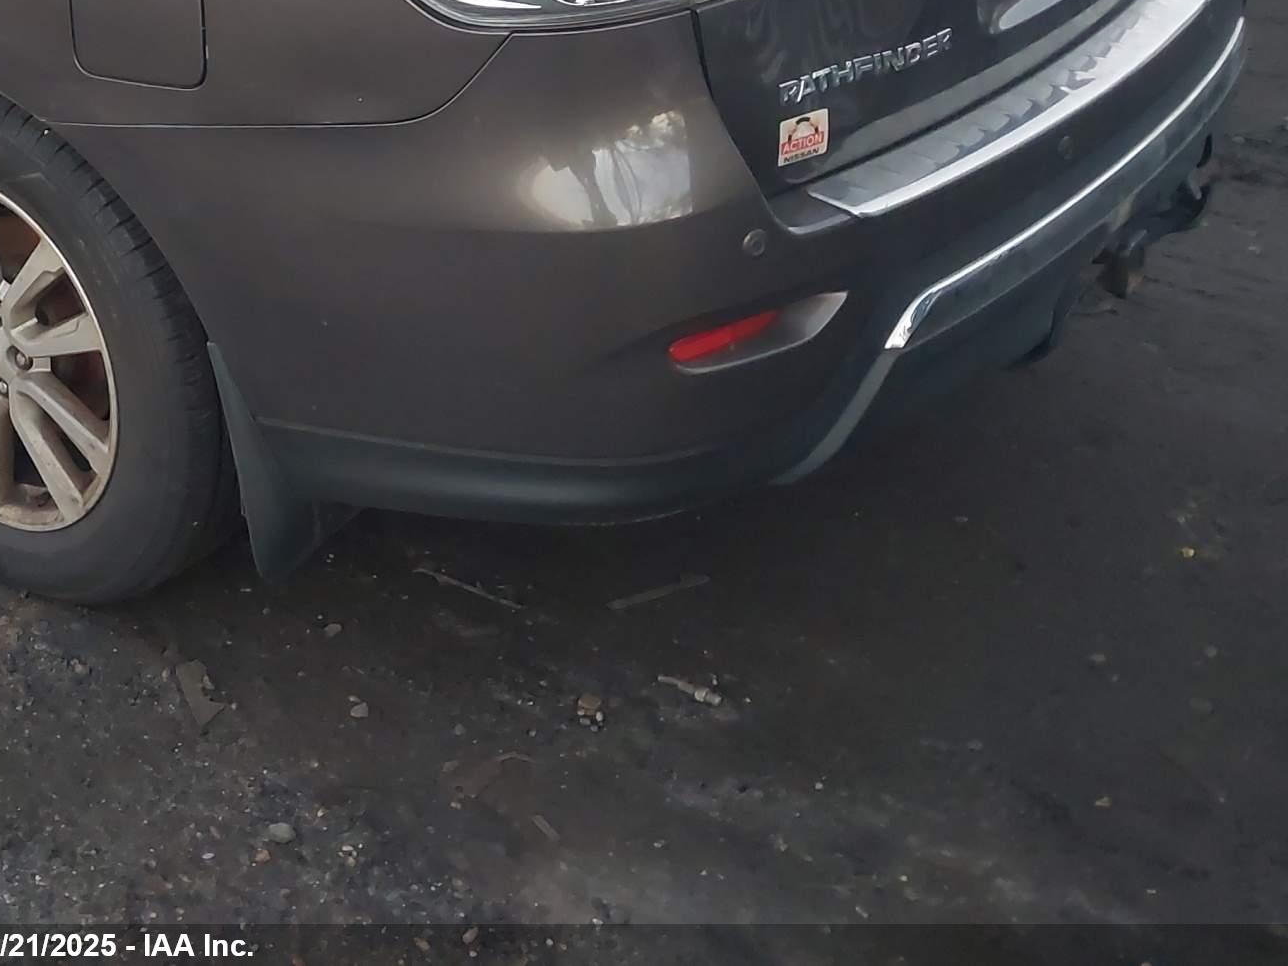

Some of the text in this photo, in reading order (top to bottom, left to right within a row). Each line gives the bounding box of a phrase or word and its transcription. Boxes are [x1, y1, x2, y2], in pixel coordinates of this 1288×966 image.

[778, 27, 953, 104] PATHFINDER
[782, 131, 824, 155] ACTION
[783, 148, 820, 163] NISSAN
